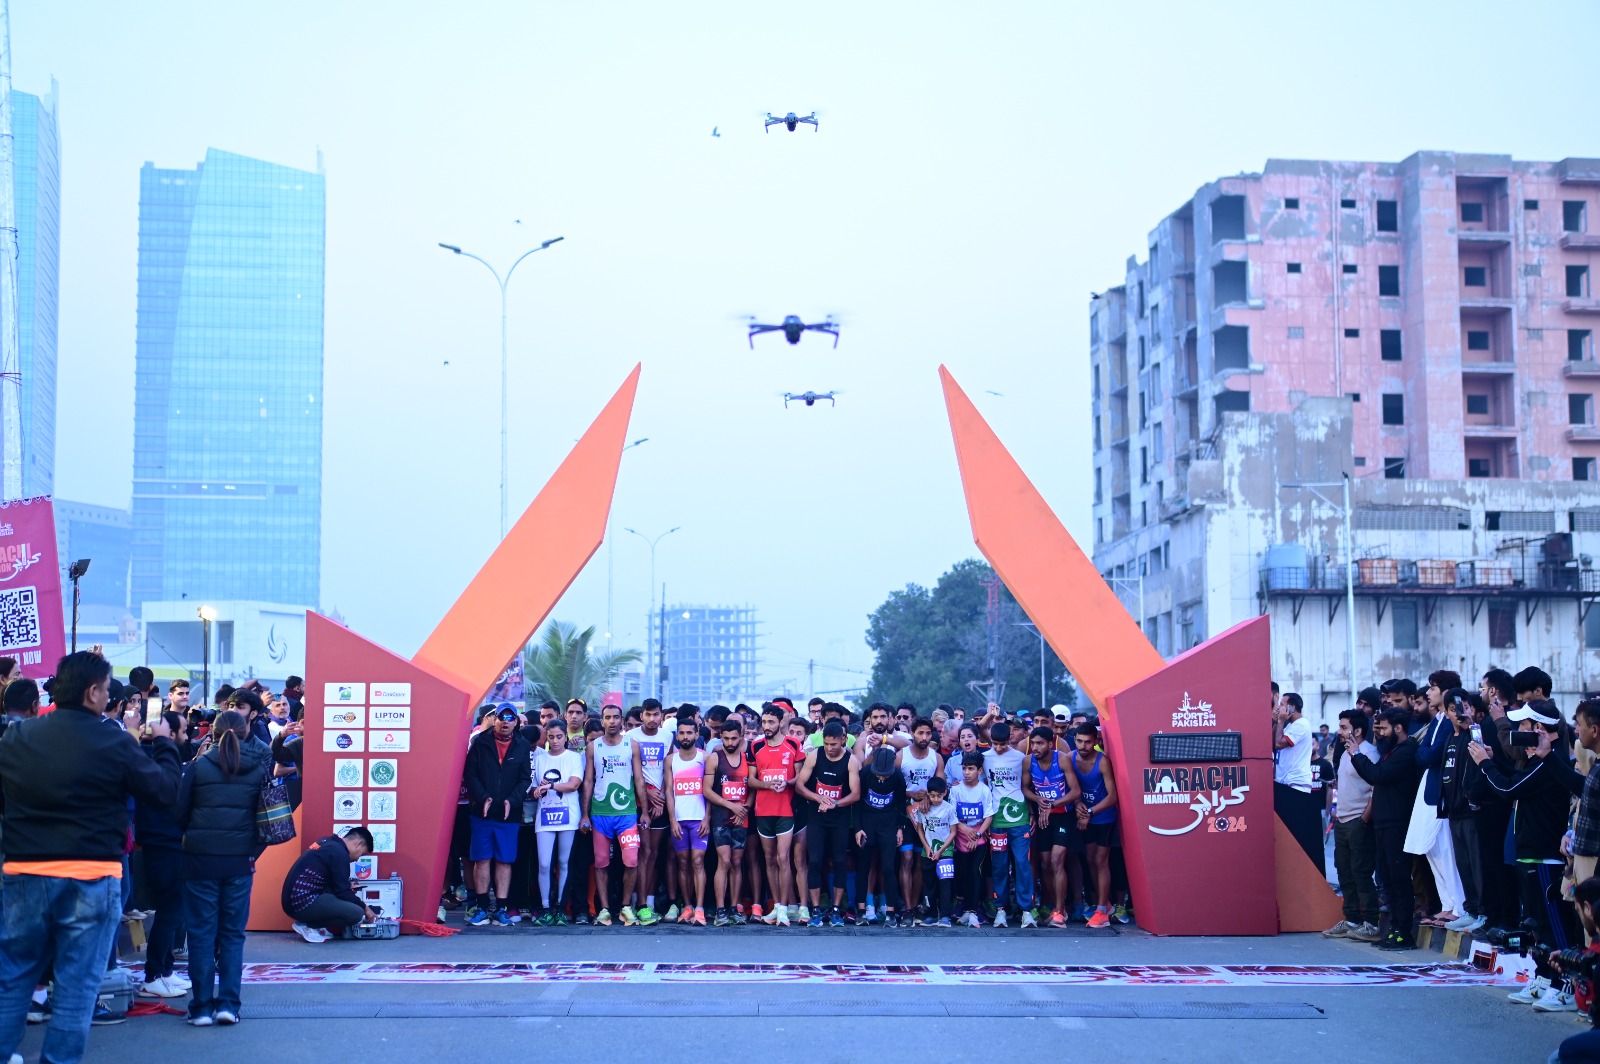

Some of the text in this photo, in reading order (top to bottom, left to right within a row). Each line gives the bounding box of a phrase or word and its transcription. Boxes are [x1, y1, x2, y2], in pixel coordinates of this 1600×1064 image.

[23, 650, 41, 665] NOW
[1172, 712, 1208, 720] SPORTS
[1172, 719, 1216, 727] PAKISTAN
[643, 747, 660, 756] 1137
[1143, 766, 1248, 792] KARACHI
[676, 781, 701, 790] 0039
[724, 786, 745, 795] 0043
[1144, 793, 1190, 804] MARATHON
[961, 807, 979, 816] 1141
[1148, 785, 1249, 836] کراچی
[546, 812, 564, 821] 1177
[1207, 816, 1248, 833] 2024
